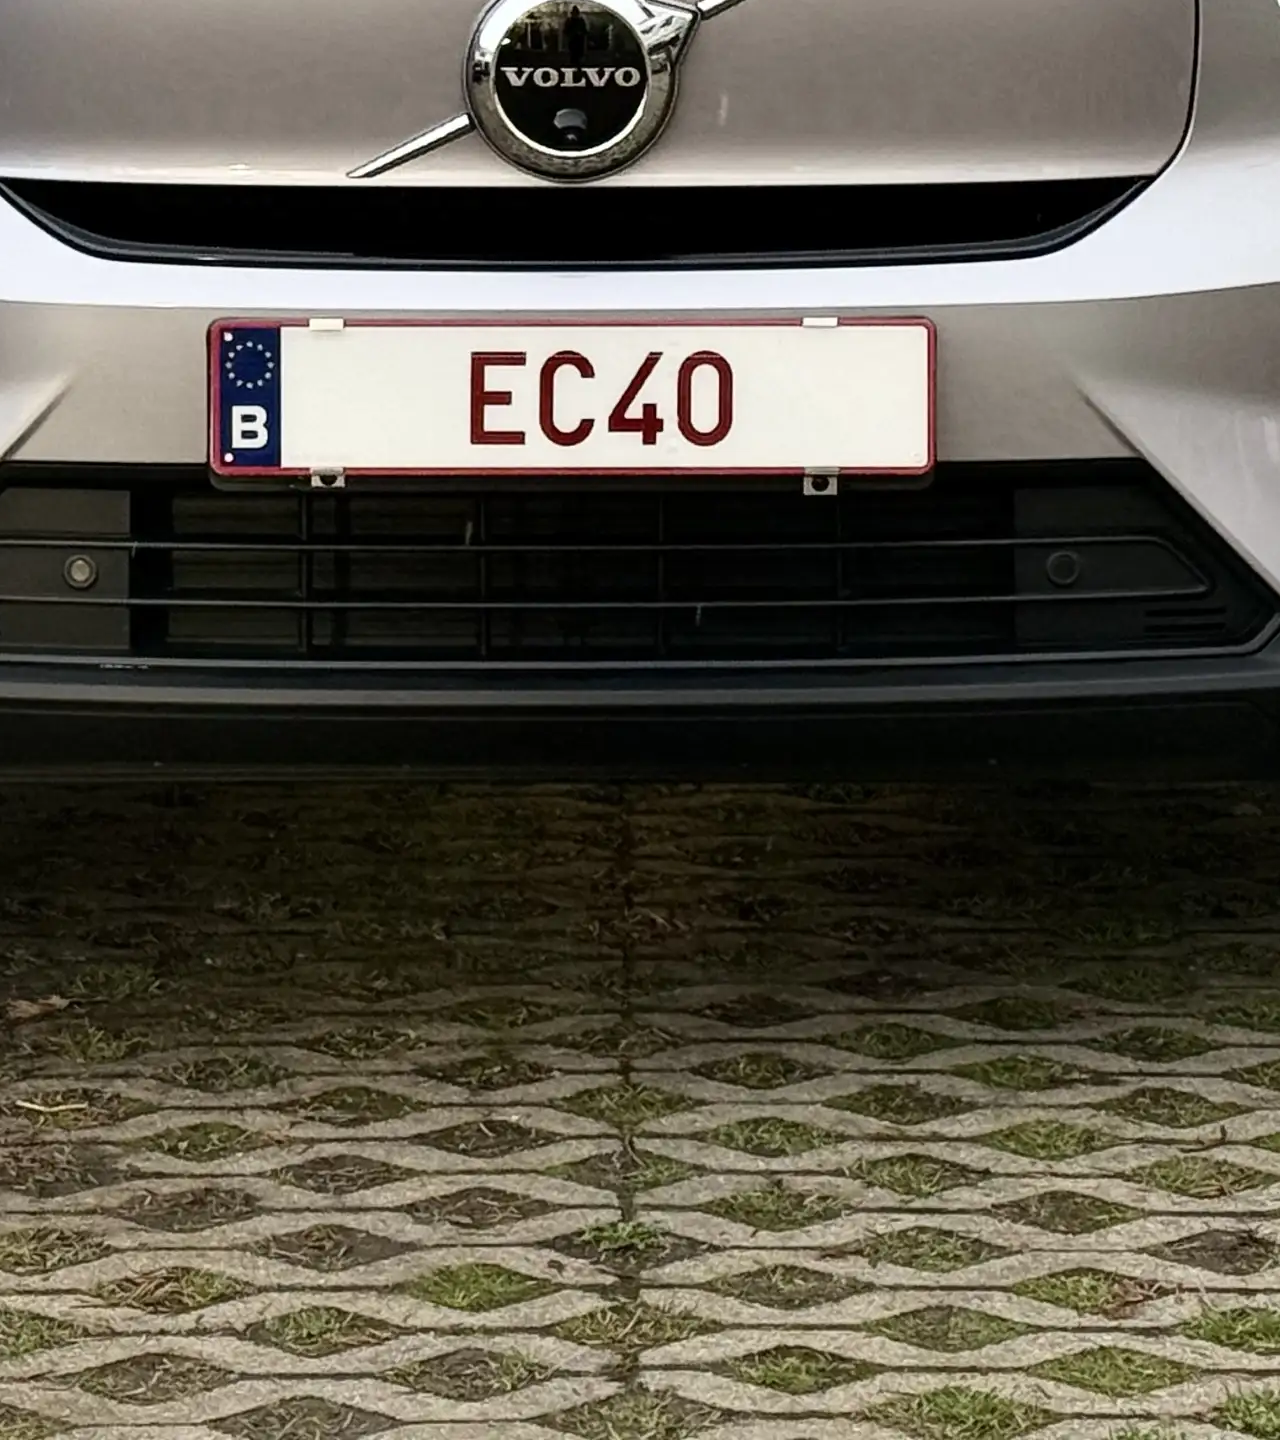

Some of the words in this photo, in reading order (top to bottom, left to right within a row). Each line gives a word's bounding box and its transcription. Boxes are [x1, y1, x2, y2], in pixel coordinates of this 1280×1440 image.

[499, 66, 641, 89] VOLVO
[469, 349, 734, 447] EC40
[230, 404, 270, 450] B
